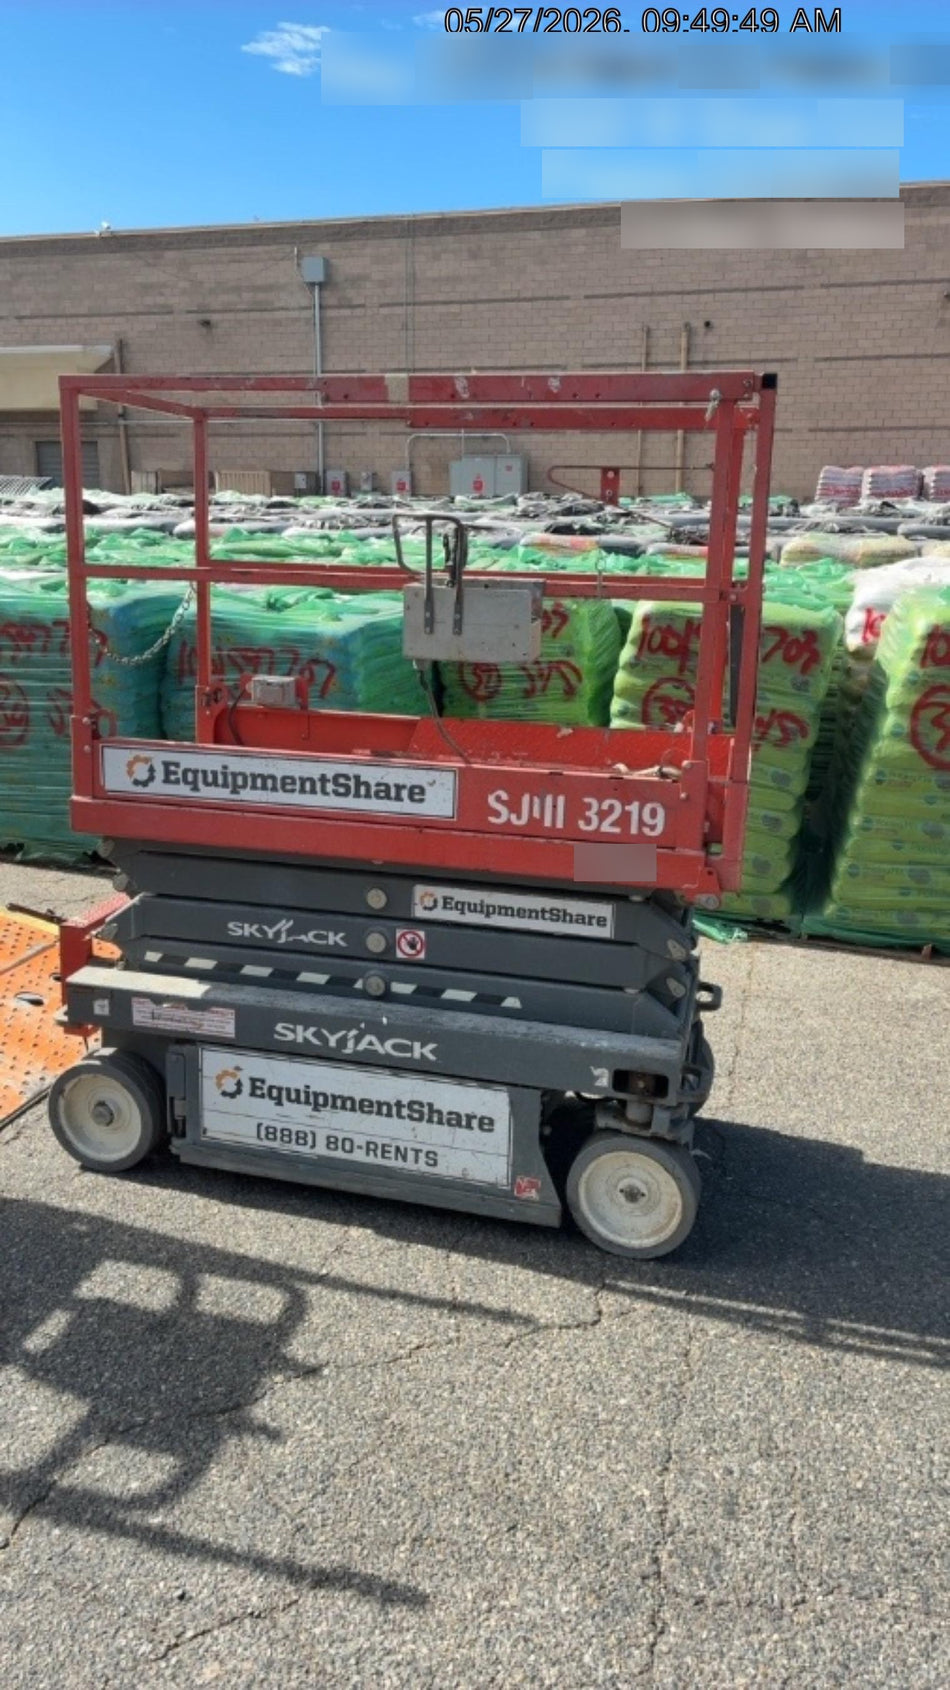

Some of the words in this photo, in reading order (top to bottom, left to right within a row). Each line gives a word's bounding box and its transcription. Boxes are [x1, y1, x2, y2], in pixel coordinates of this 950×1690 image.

[161, 760, 427, 804] EquipmentShare
[577, 797, 666, 837] 3219
[441, 895, 608, 928] EquipmentShare
[248, 1076, 496, 1133] EquipmentShare
[256, 1122, 316, 1150] (888)
[325, 1134, 439, 1168] 80-RENTS
